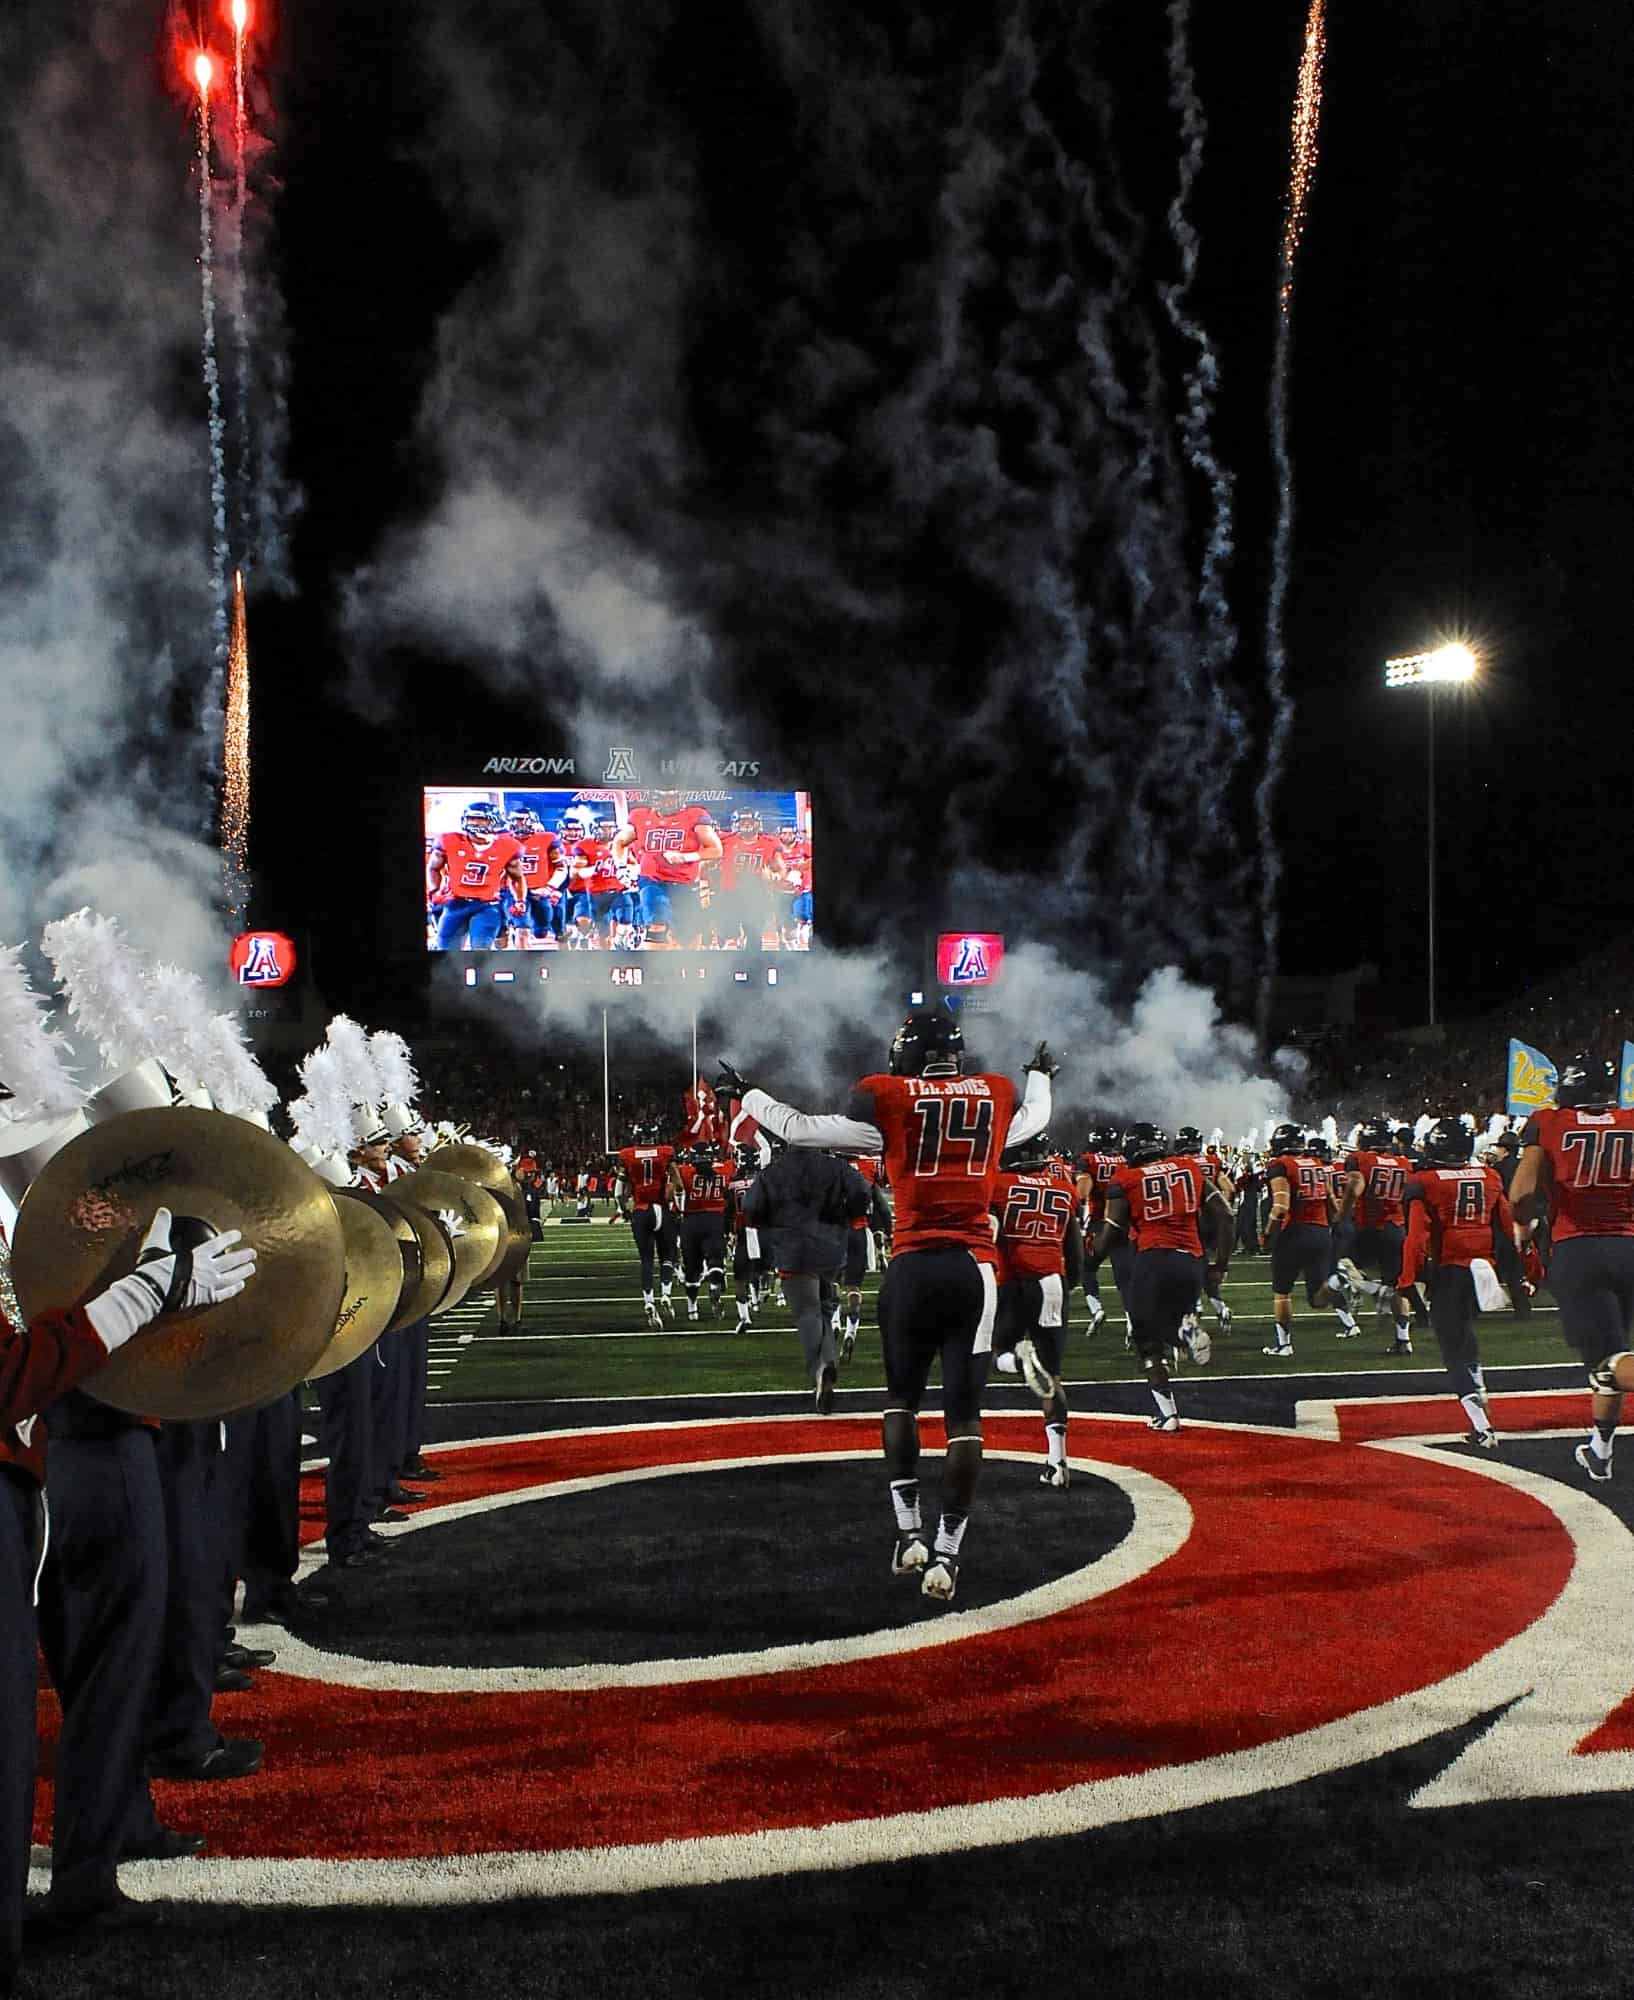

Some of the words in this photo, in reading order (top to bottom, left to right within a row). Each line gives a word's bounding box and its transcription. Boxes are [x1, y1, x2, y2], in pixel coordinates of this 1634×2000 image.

[482, 757, 575, 775] ARIZONA
[603, 748, 640, 782] A
[645, 829, 685, 852] 62
[461, 862, 489, 886] 3
[239, 936, 282, 985] A
[948, 938, 989, 983] A
[914, 1098, 994, 1176] 14
[1561, 1130, 1634, 1187] 70
[641, 1158, 654, 1186] 1
[1368, 1166, 1407, 1200] 60
[1003, 1185, 1073, 1241] 25
[1142, 1169, 1197, 1221] 97
[1453, 1179, 1486, 1226] 8
